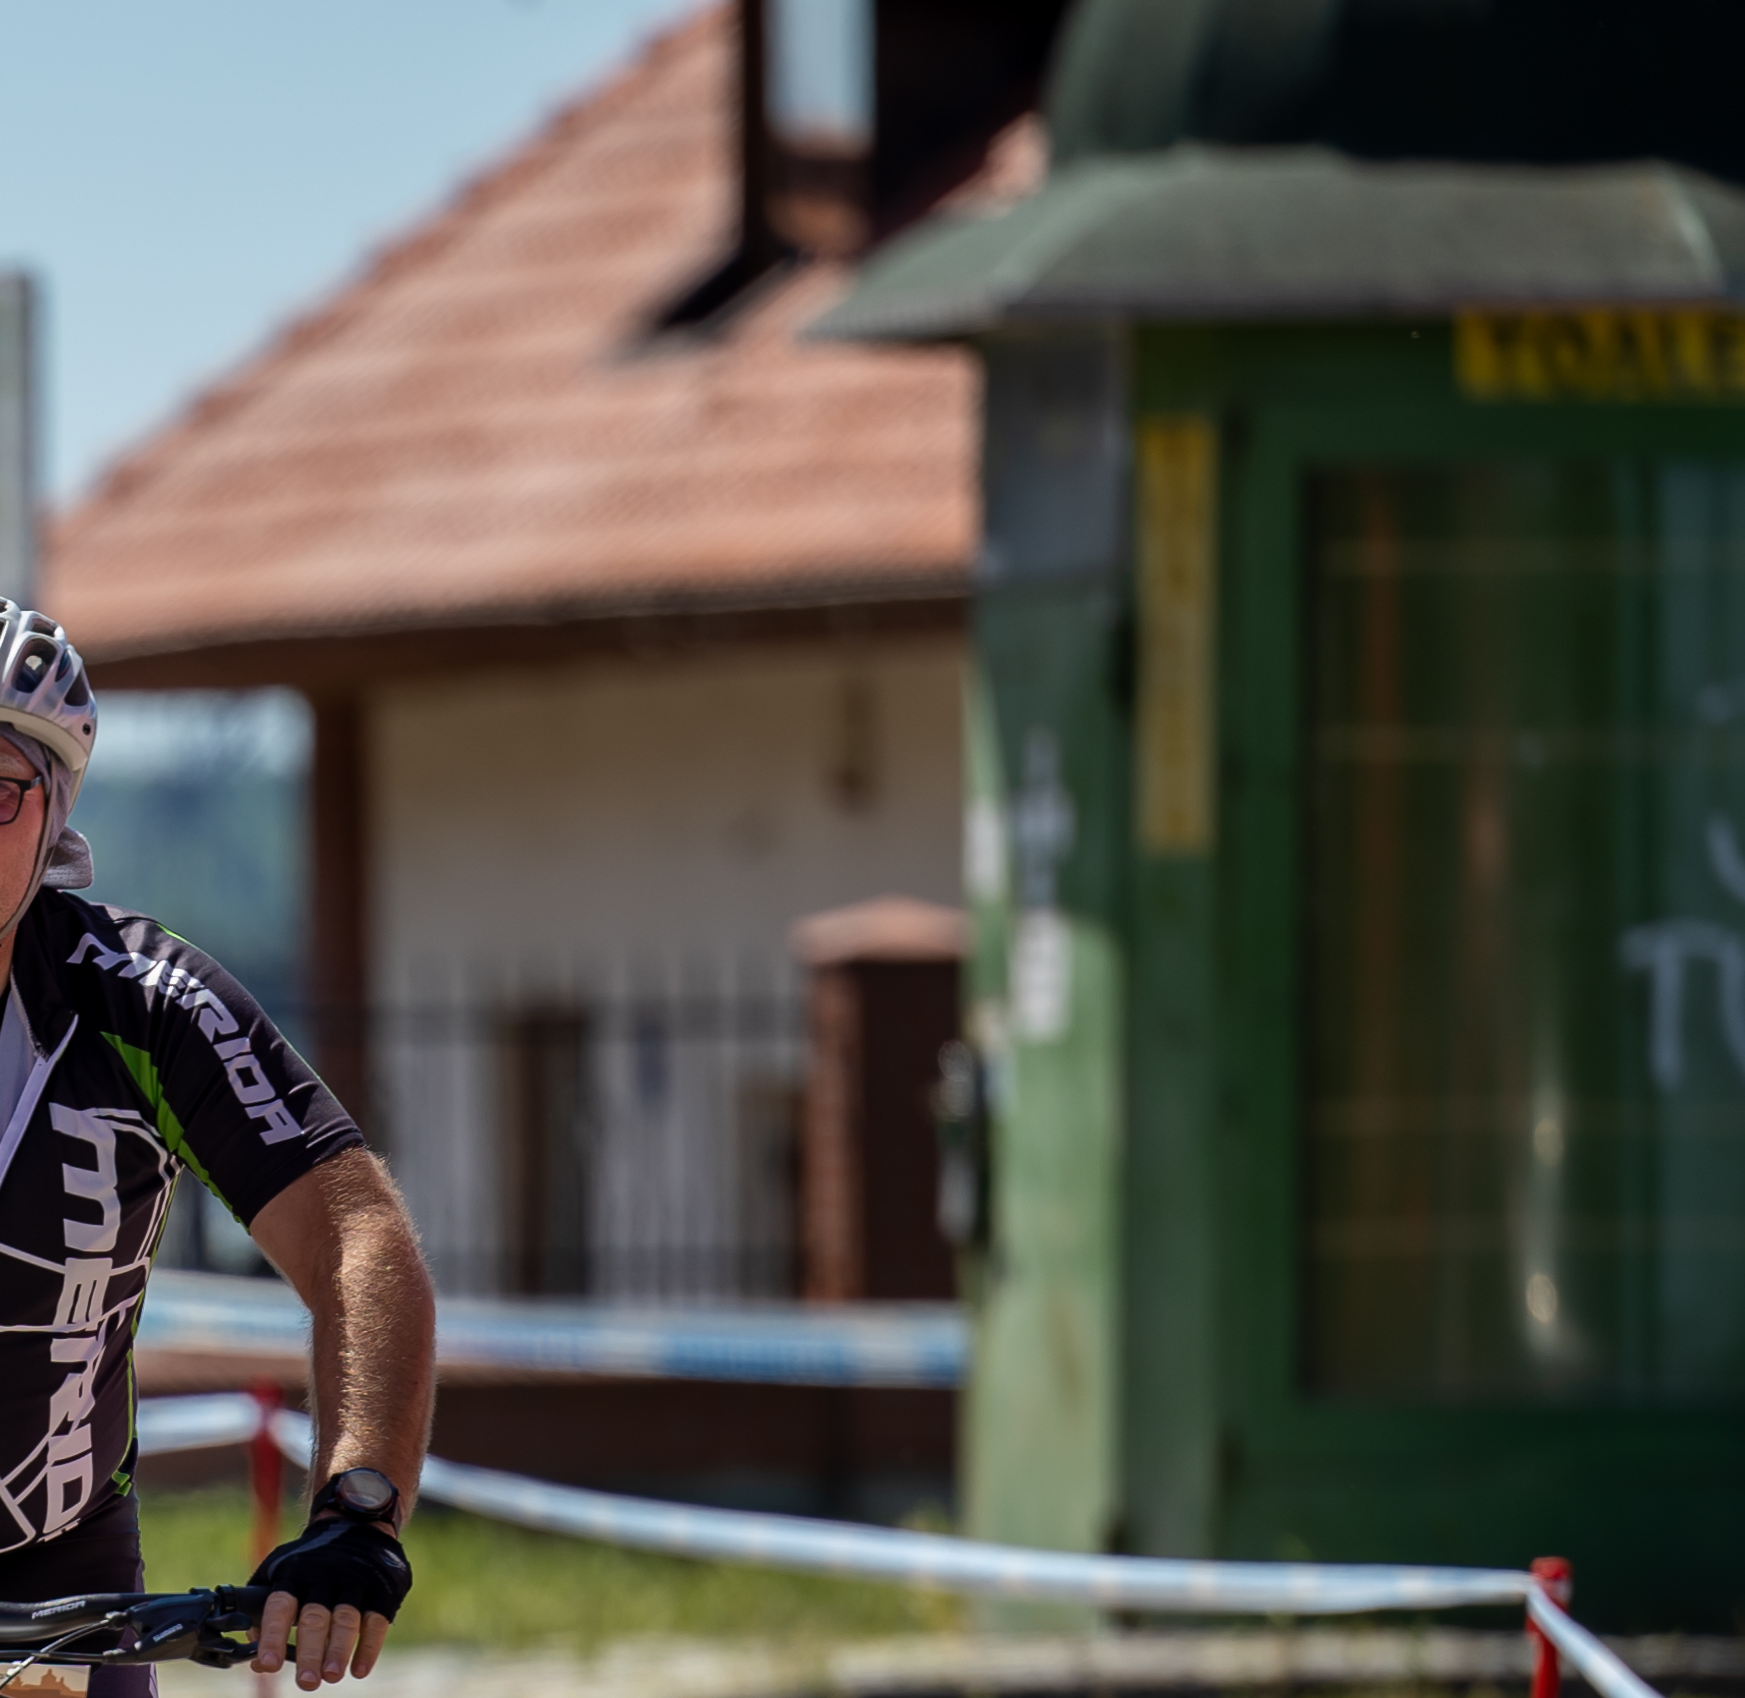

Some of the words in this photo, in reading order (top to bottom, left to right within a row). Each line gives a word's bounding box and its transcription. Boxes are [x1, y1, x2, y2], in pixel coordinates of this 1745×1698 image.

[65, 932, 305, 1146] MERIDA
[38, 1102, 122, 1541] MERID
[31, 1600, 86, 1620] MERIDA
